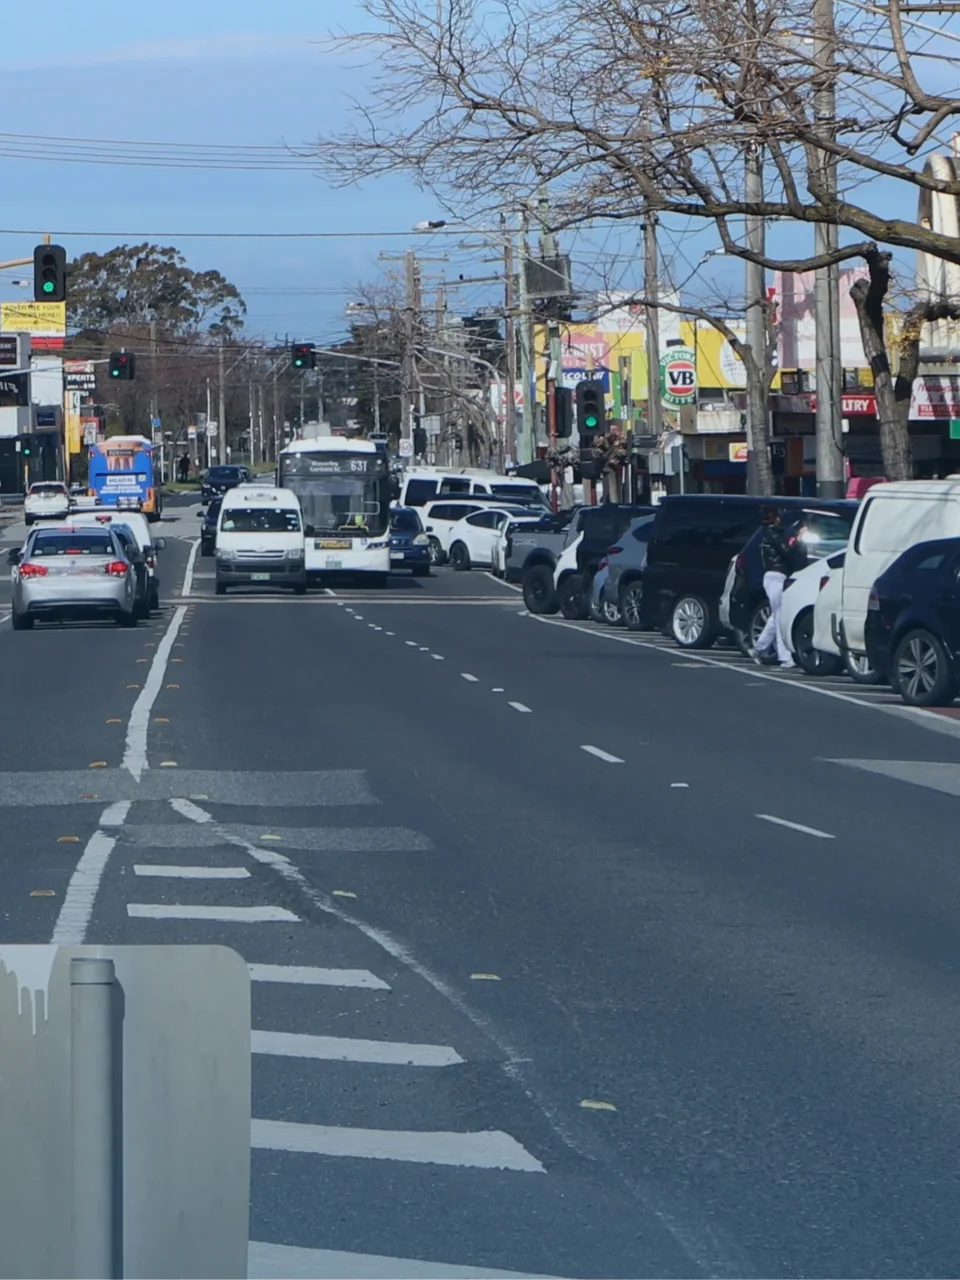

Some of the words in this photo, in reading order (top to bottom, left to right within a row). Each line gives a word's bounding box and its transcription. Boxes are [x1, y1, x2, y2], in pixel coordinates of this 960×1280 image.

[668, 371, 695, 386] VB
[841, 399, 870, 412] LTRY
[350, 460, 367, 472] 631
